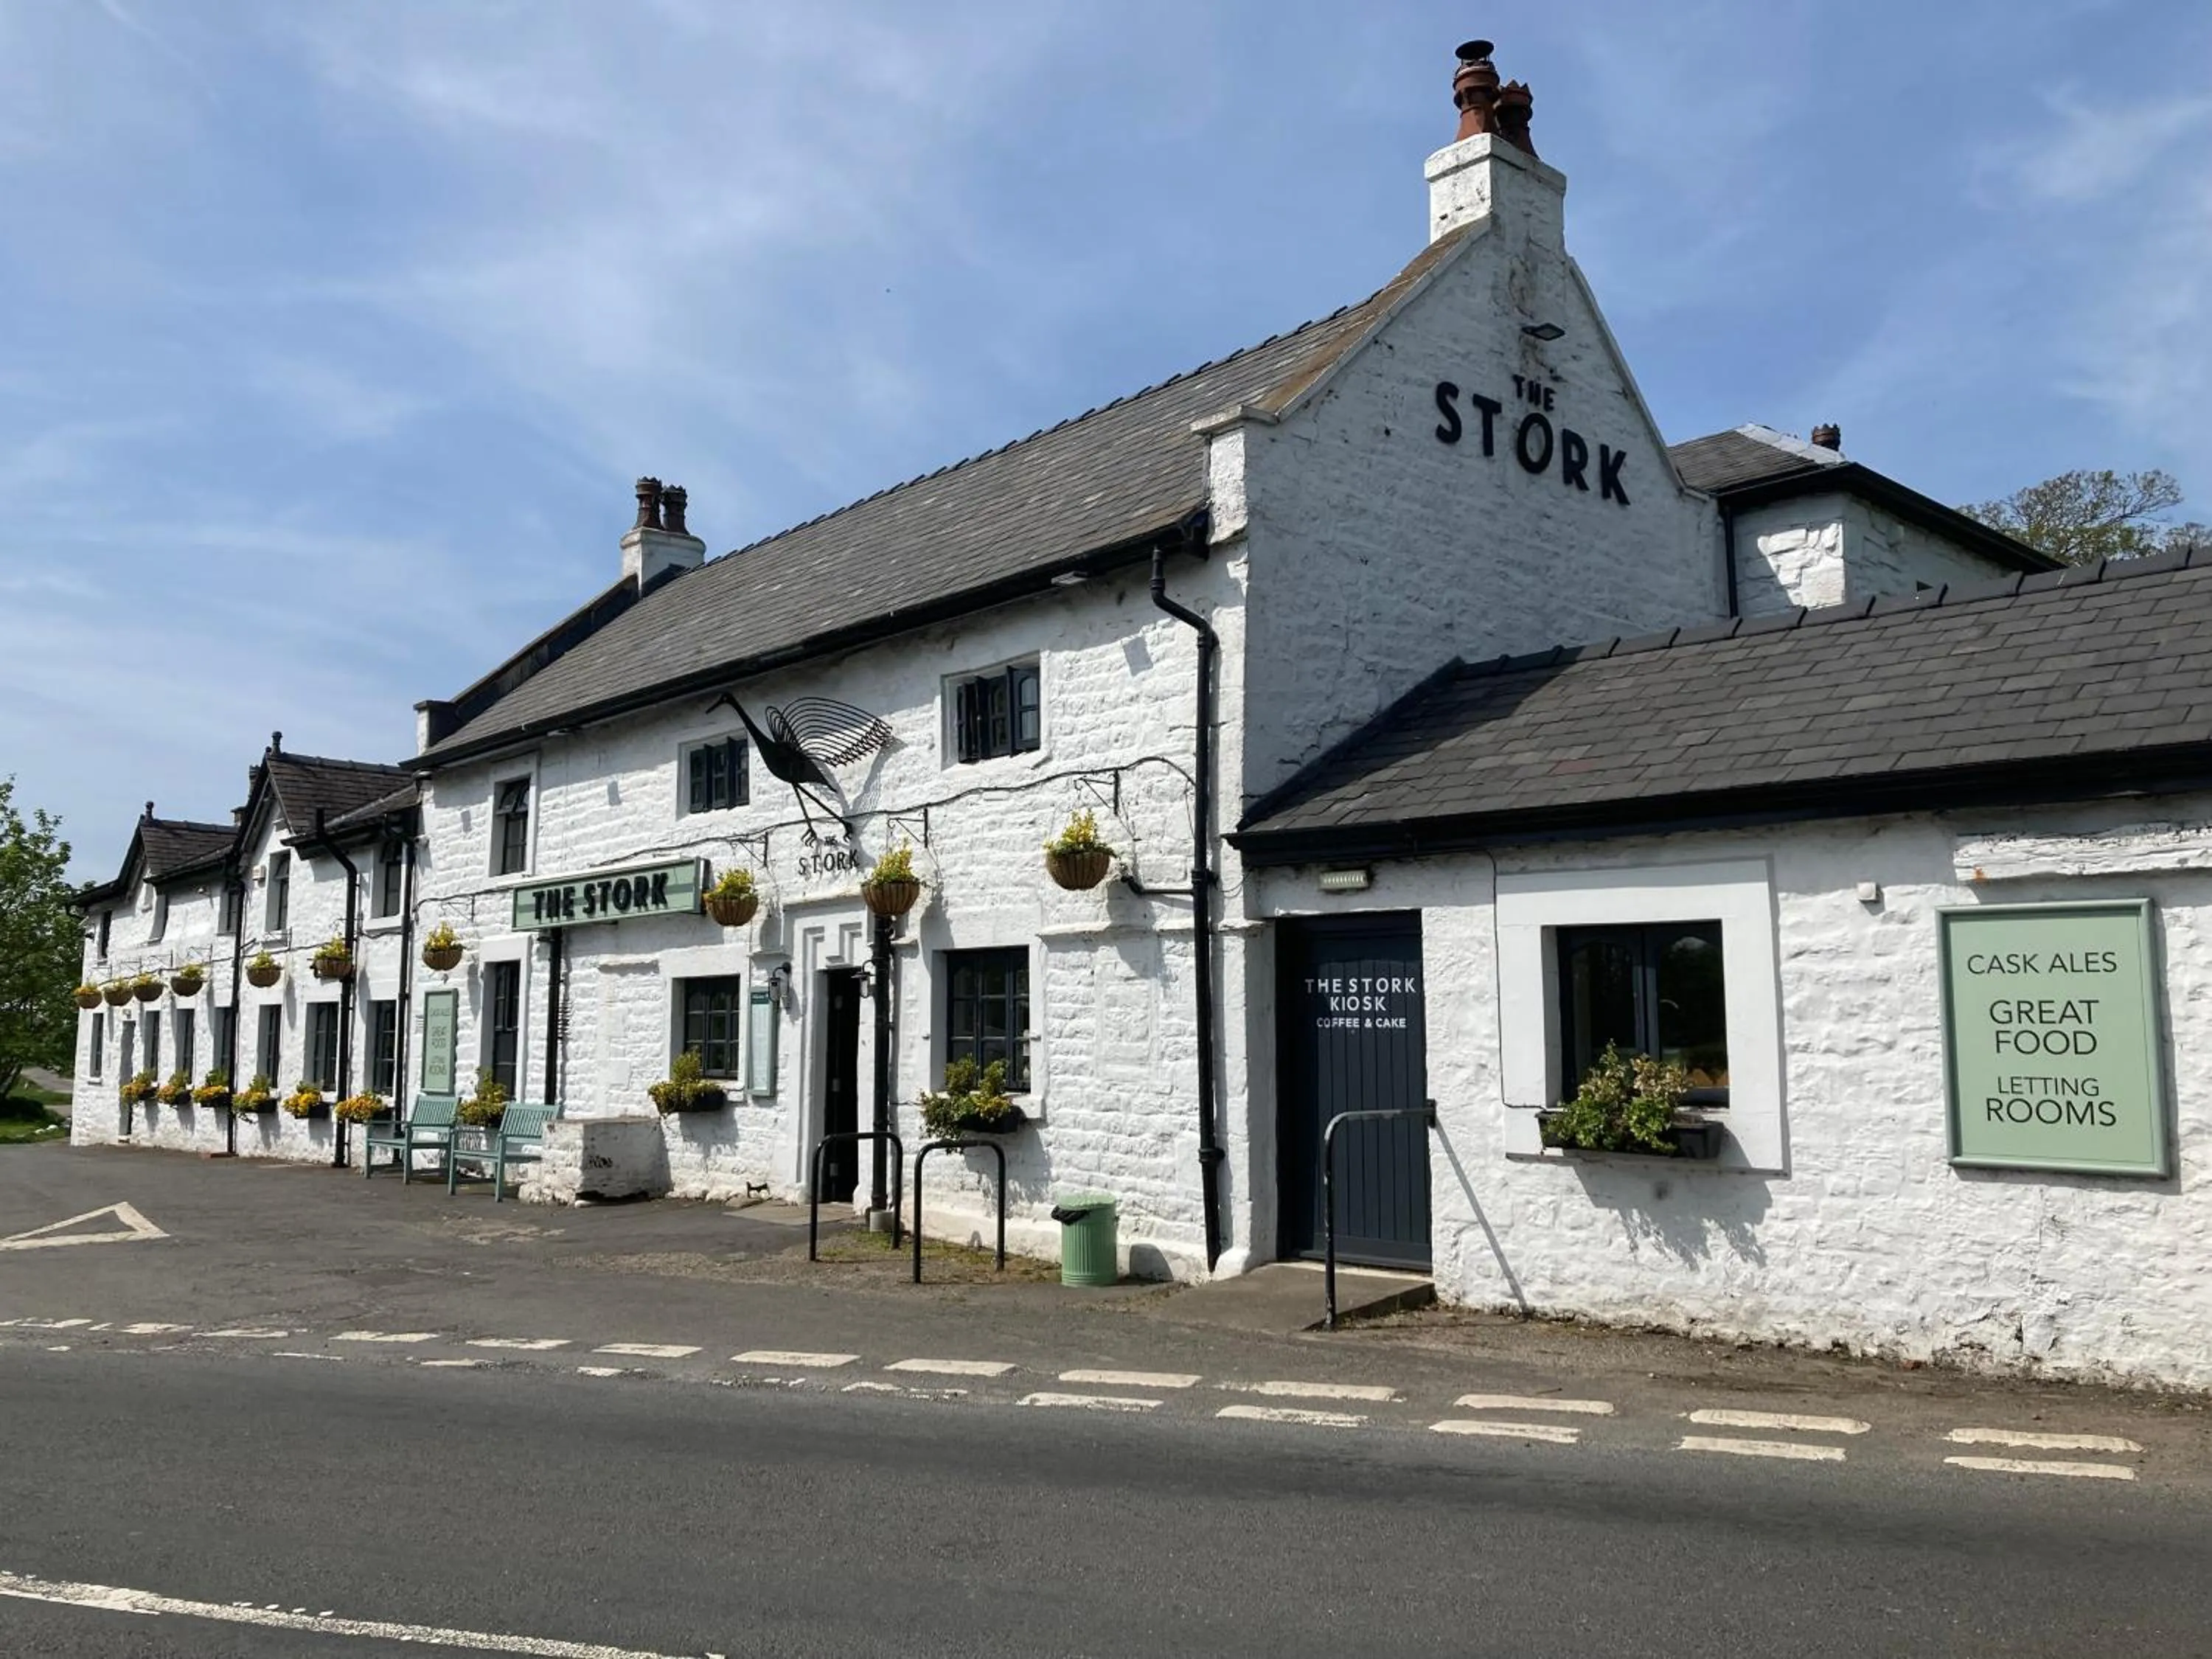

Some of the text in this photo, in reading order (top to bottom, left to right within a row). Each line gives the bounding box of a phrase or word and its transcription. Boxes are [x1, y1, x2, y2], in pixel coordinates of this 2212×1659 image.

[1513, 374, 1557, 411] THE
[1435, 381, 1630, 505] STORK
[798, 849, 860, 876] STORK
[532, 872, 669, 920] THE STORK
[1967, 952, 2118, 975] CASK ALES
[1305, 977, 1416, 993] THE STORK
[1329, 996, 1386, 1011] KIOSK
[1989, 1000, 2099, 1025] GREAT
[1316, 1018, 1407, 1028] COFFEE & CAKE
[1995, 1030, 2097, 1055] FOOD
[1997, 1077, 2100, 1096] LETTING
[1986, 1098, 2117, 1127] ROOMS
